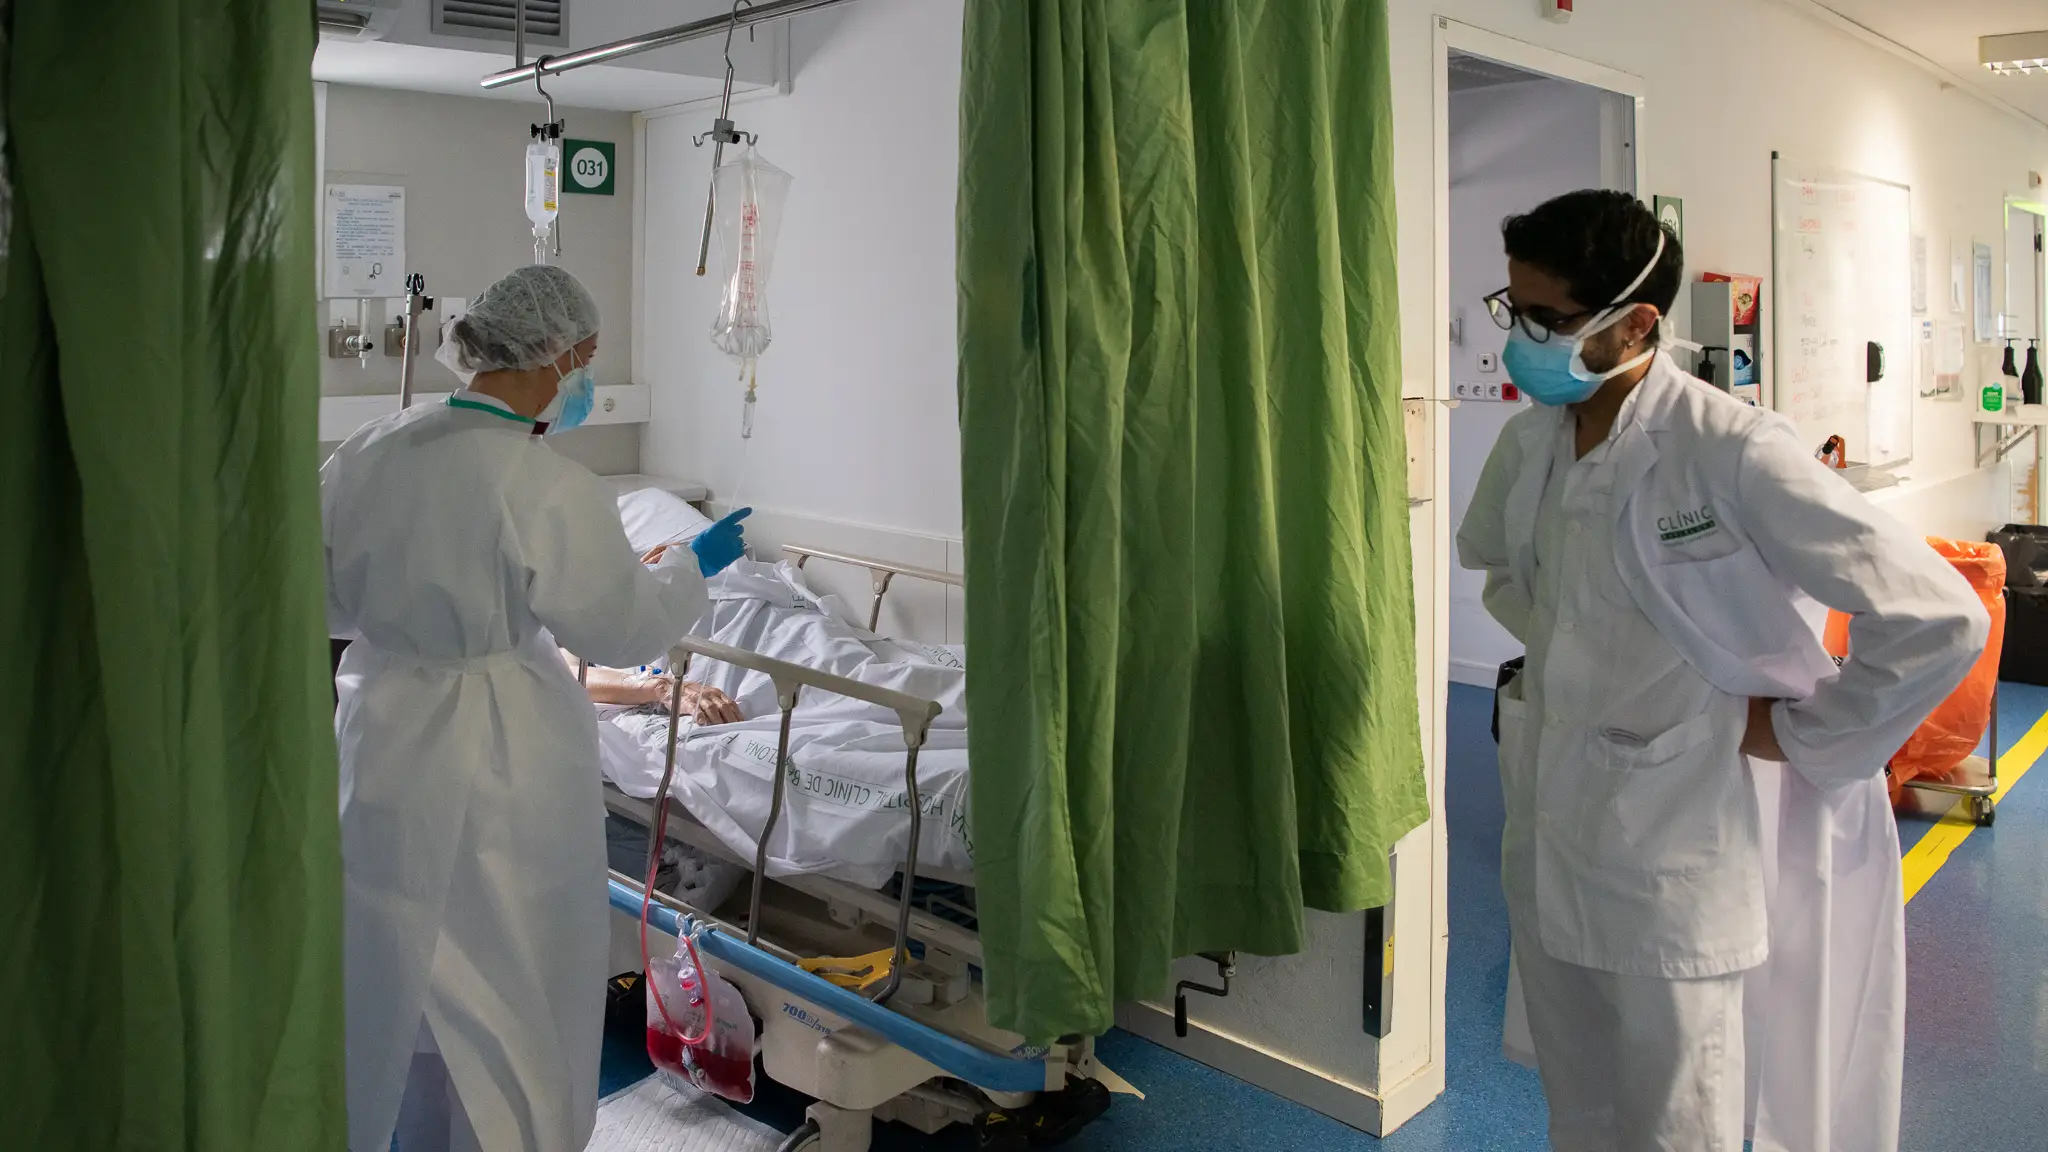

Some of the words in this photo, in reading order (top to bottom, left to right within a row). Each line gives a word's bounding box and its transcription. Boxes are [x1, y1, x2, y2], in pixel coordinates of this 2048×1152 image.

[577, 159, 603, 177] 031
[1657, 505, 1712, 532] CLÍNIC
[744, 739, 801, 787] BALONA
[805, 773, 821, 793] DE
[826, 778, 871, 806] CLÍNIC
